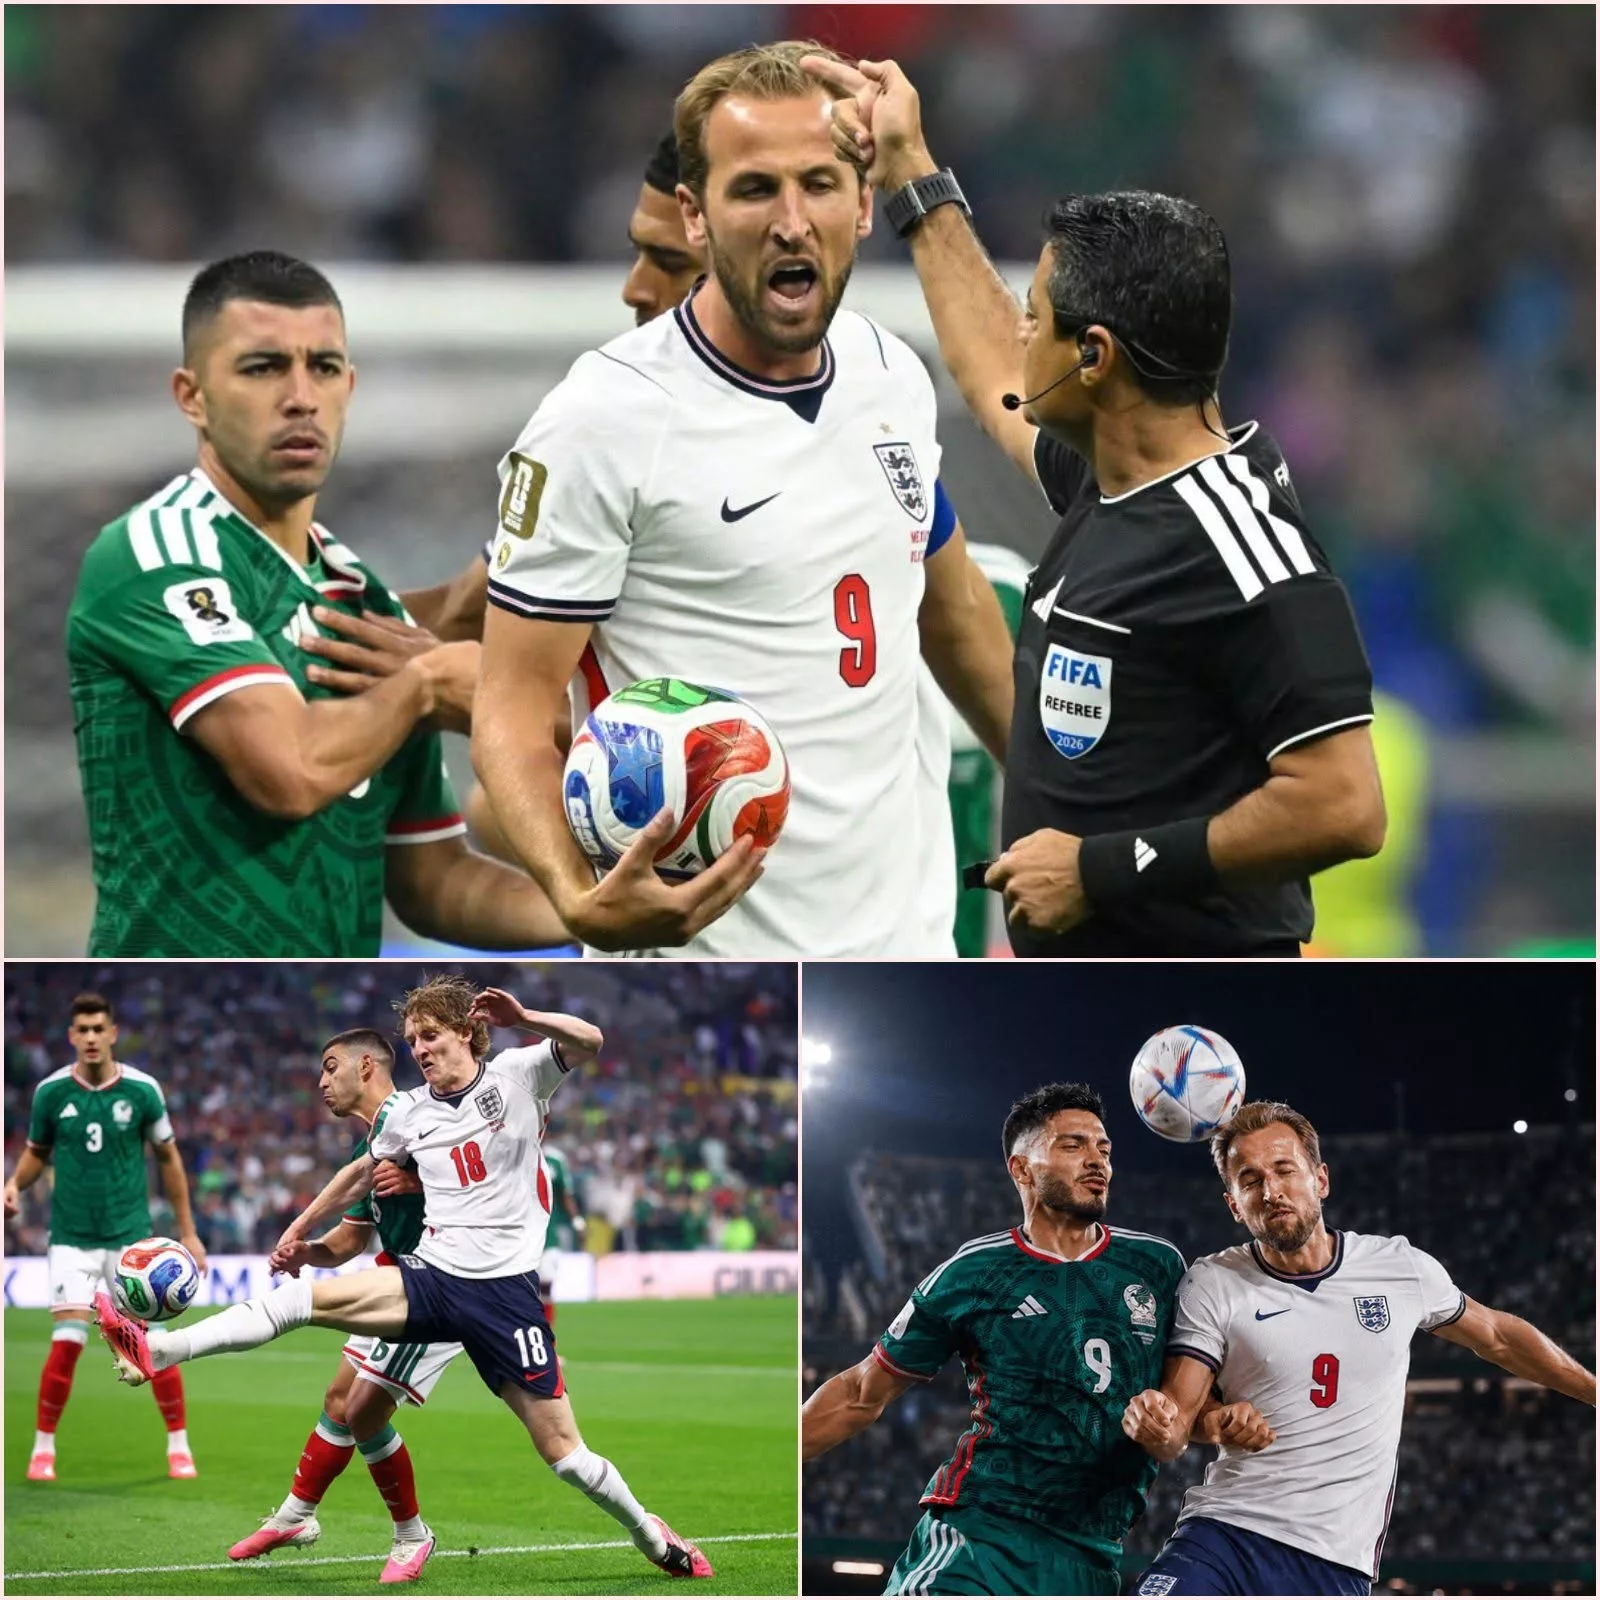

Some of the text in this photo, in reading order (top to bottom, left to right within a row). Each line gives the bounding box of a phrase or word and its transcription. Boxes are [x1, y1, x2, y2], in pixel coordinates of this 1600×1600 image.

[833, 573, 876, 688] 9
[1048, 653, 1102, 690] FIFA
[1045, 695, 1103, 719] REFEREE
[1057, 734, 1085, 750] 2026
[86, 1122, 103, 1153] 3
[449, 1140, 487, 1188] 18
[513, 1326, 549, 1368] 18
[1083, 1338, 1112, 1394] 9
[1309, 1353, 1340, 1409] 9
